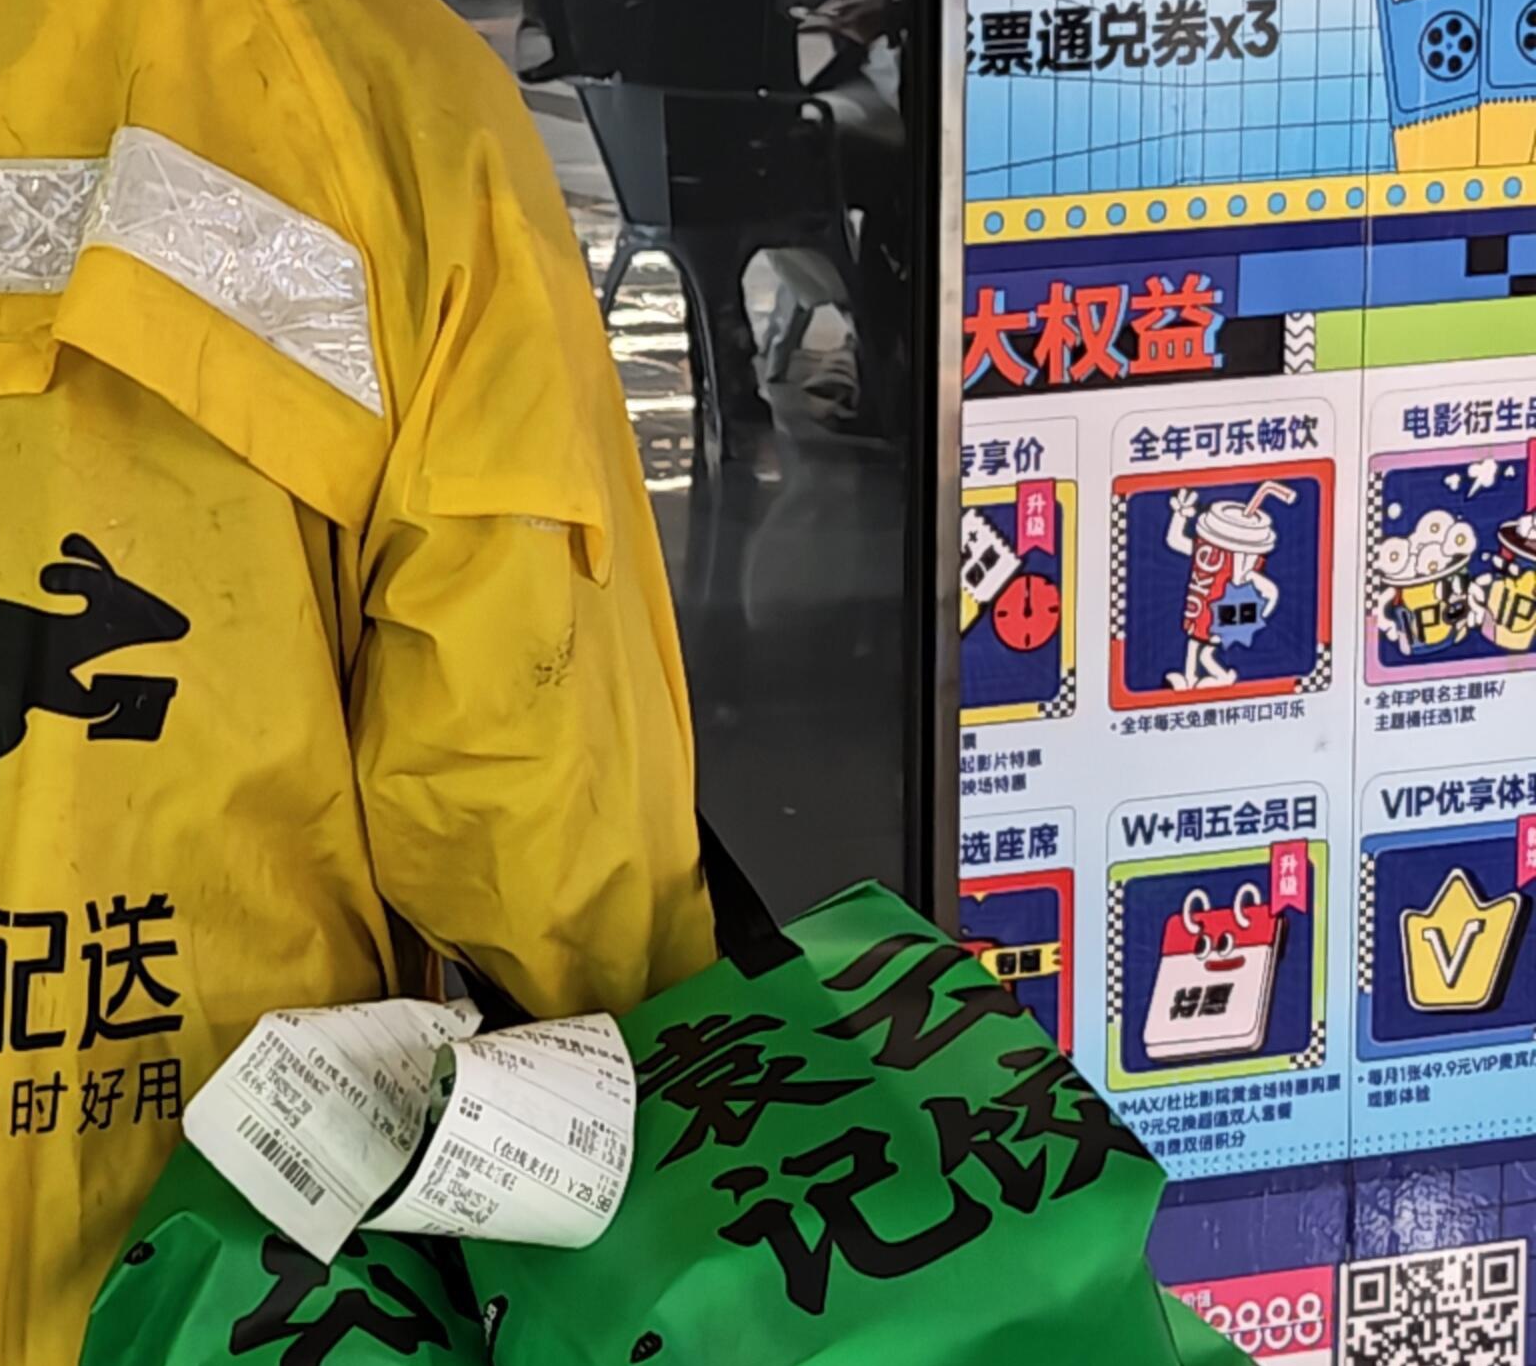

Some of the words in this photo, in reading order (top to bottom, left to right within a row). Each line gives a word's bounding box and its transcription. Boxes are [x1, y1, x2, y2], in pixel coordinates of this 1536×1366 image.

[963, 272, 1223, 390] 大权益
[1128, 414, 1319, 463] 全年可乐畅饮
[1026, 493, 1046, 536] 升级
[1119, 699, 1306, 735] 全年每天免费1杯可口可乐
[1121, 795, 1319, 848] W+周五会员日
[960, 823, 1060, 866] 选座席
[1279, 852, 1299, 897] 升级
[1142, 1130, 1247, 1157] 消费双倍积分
